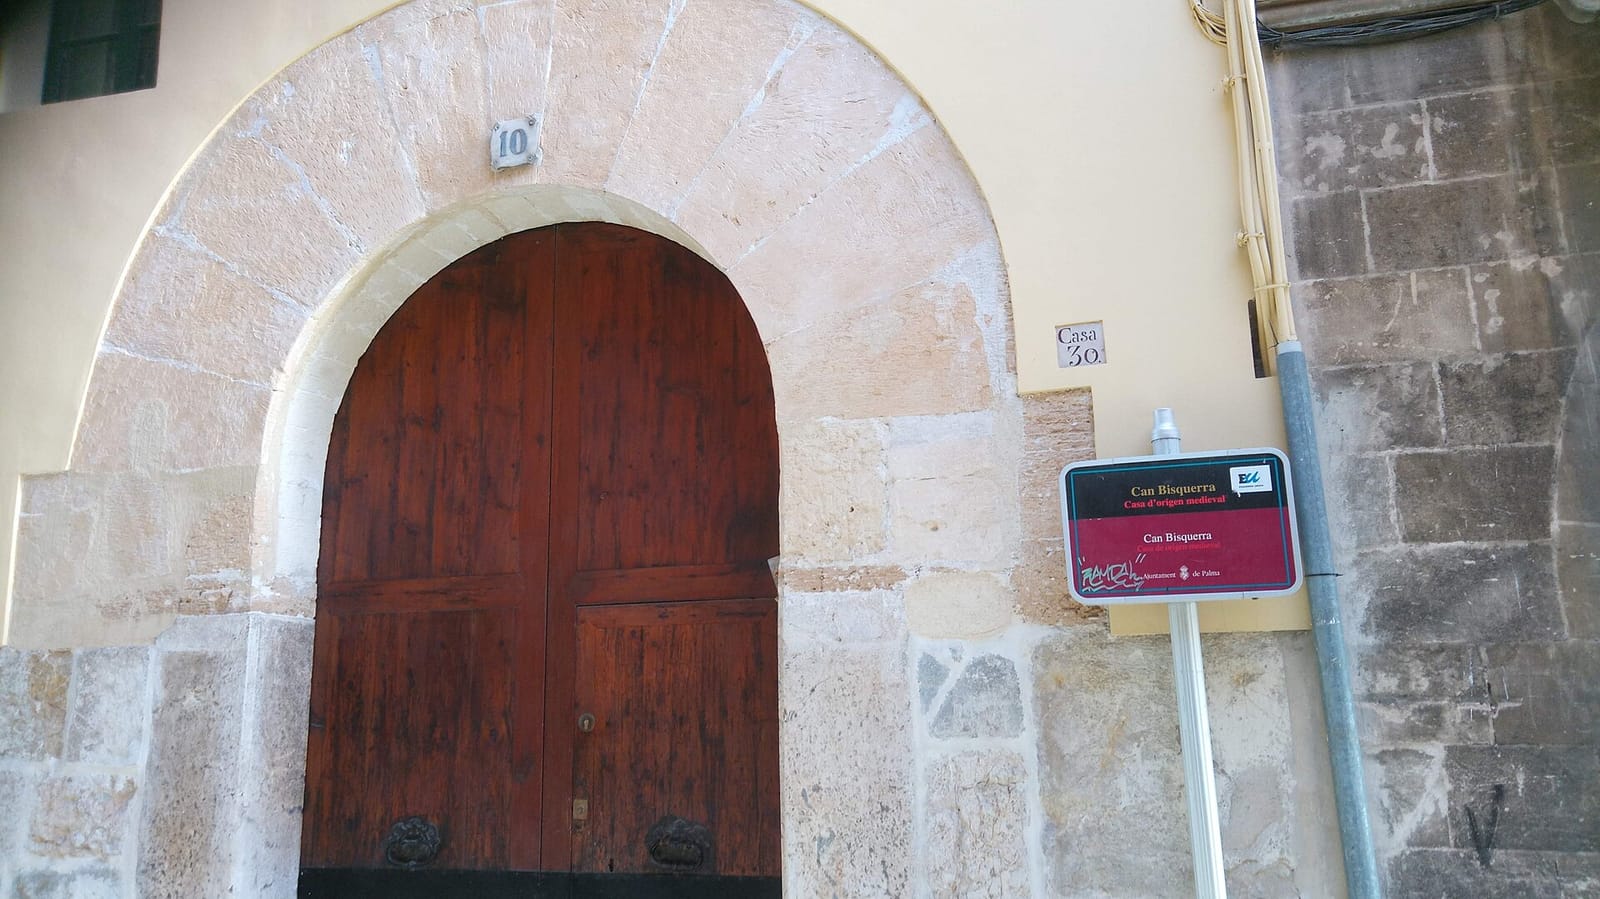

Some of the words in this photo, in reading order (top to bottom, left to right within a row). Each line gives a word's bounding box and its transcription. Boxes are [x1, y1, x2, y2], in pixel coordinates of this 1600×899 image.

[500, 129, 527, 157] 10
[1058, 327, 1096, 344] Casa
[1131, 486, 1155, 497] Can
[1158, 483, 1216, 496] Bisquerra
[1124, 500, 1146, 509] Casa
[1147, 498, 1184, 508] d'origen
[1186, 494, 1226, 505] medieval
[1143, 533, 1163, 544] Can
[1165, 531, 1212, 544] Bisquerra
[1143, 572, 1176, 580] Ajuntament
[1201, 569, 1220, 577] Palma
